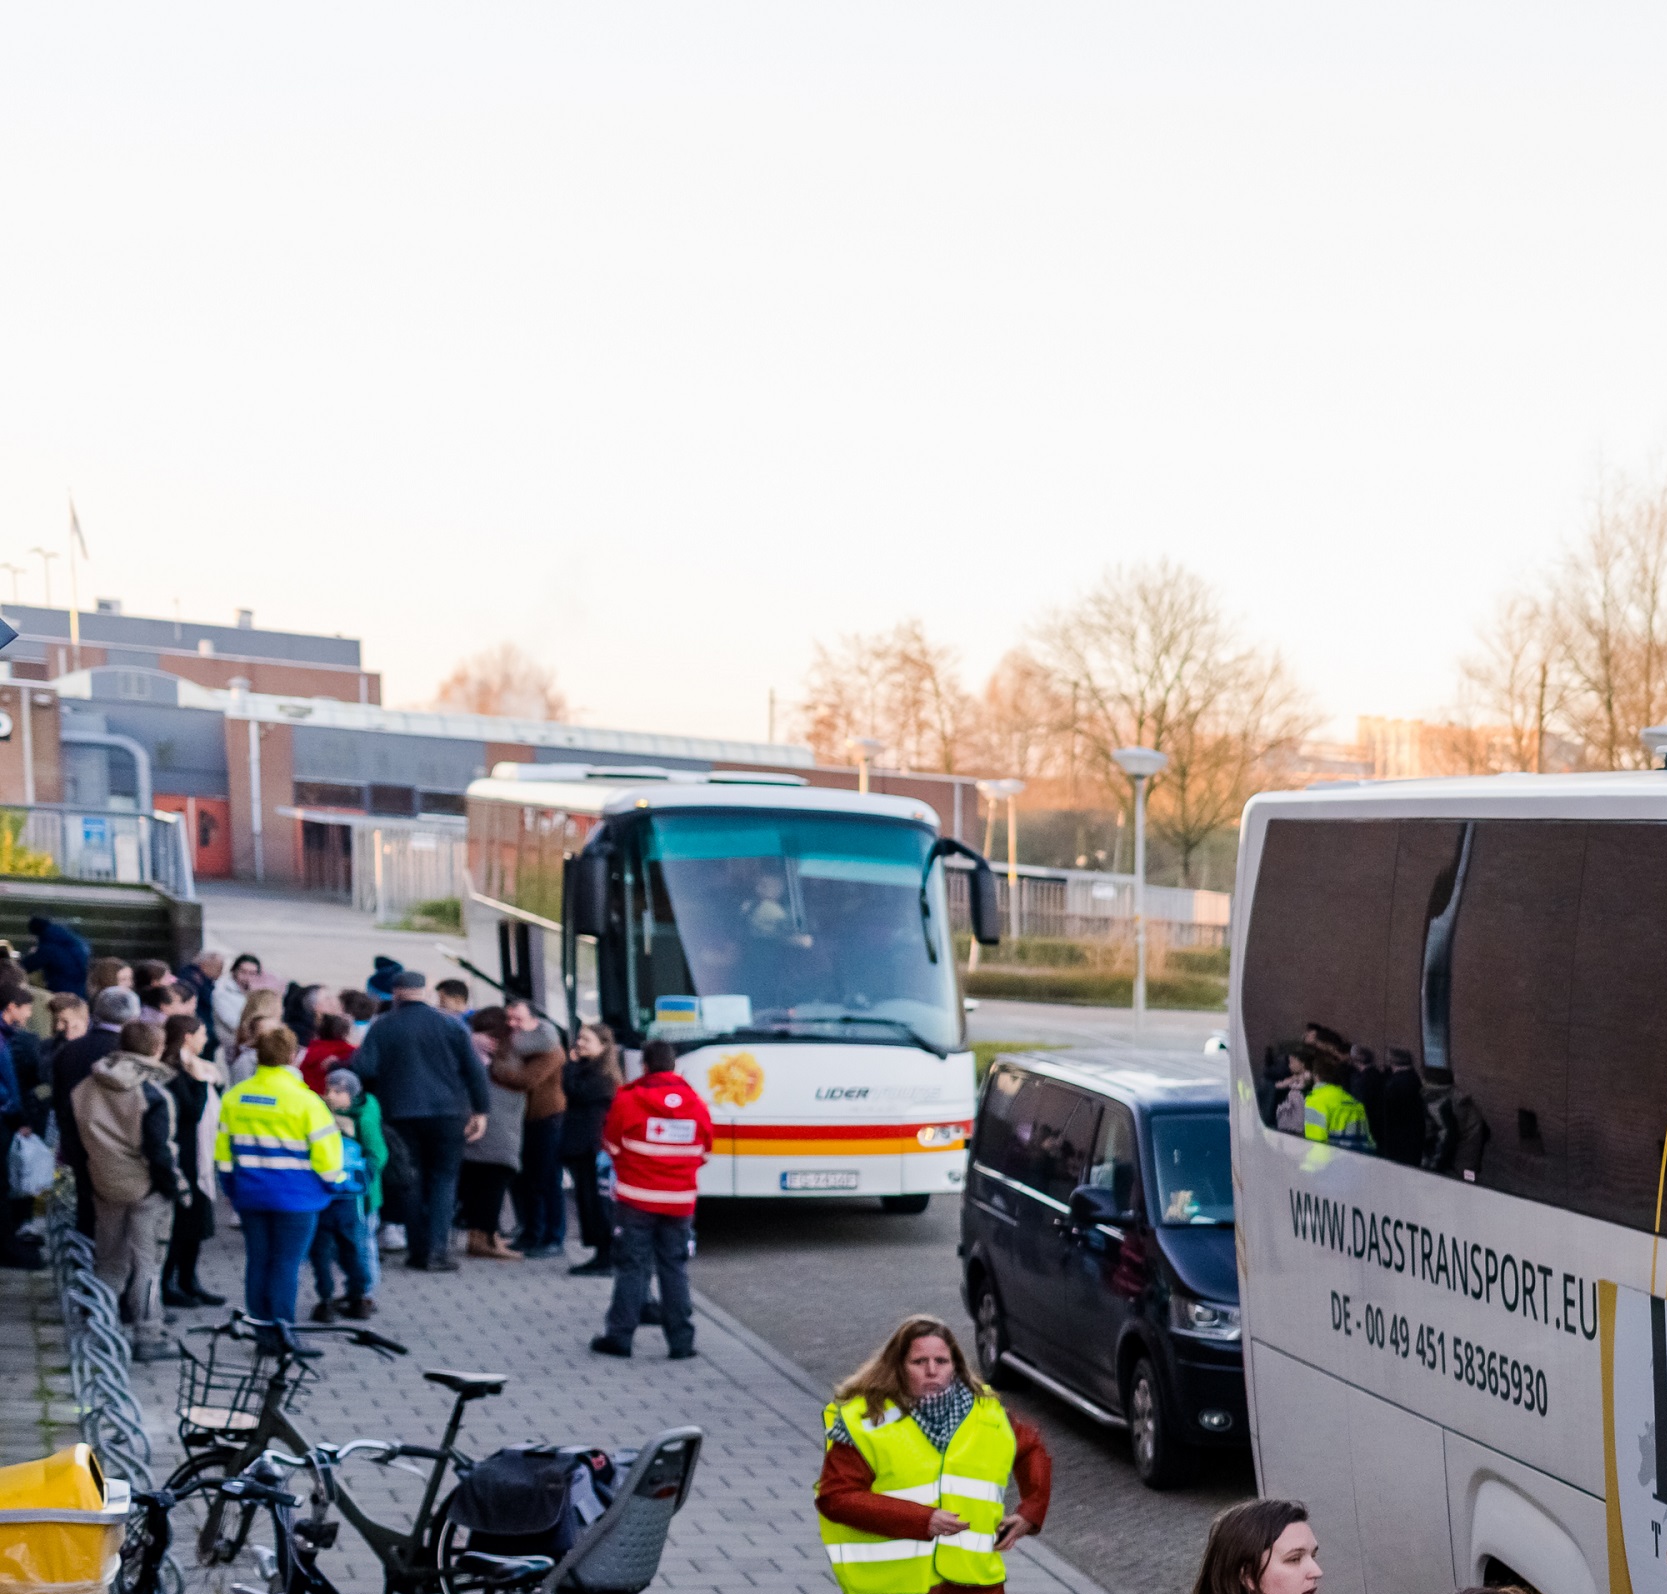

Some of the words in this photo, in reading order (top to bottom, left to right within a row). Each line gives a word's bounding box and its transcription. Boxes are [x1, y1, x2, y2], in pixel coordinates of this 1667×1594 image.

[1289, 1188, 1597, 1340] WWW.DASSTRANSPORT.EU
[1331, 1290, 1352, 1336] DE
[1365, 1303, 1385, 1349] 00
[1390, 1313, 1410, 1358] 49
[1415, 1323, 1446, 1375] 451
[1453, 1336, 1548, 1417] 58365930
